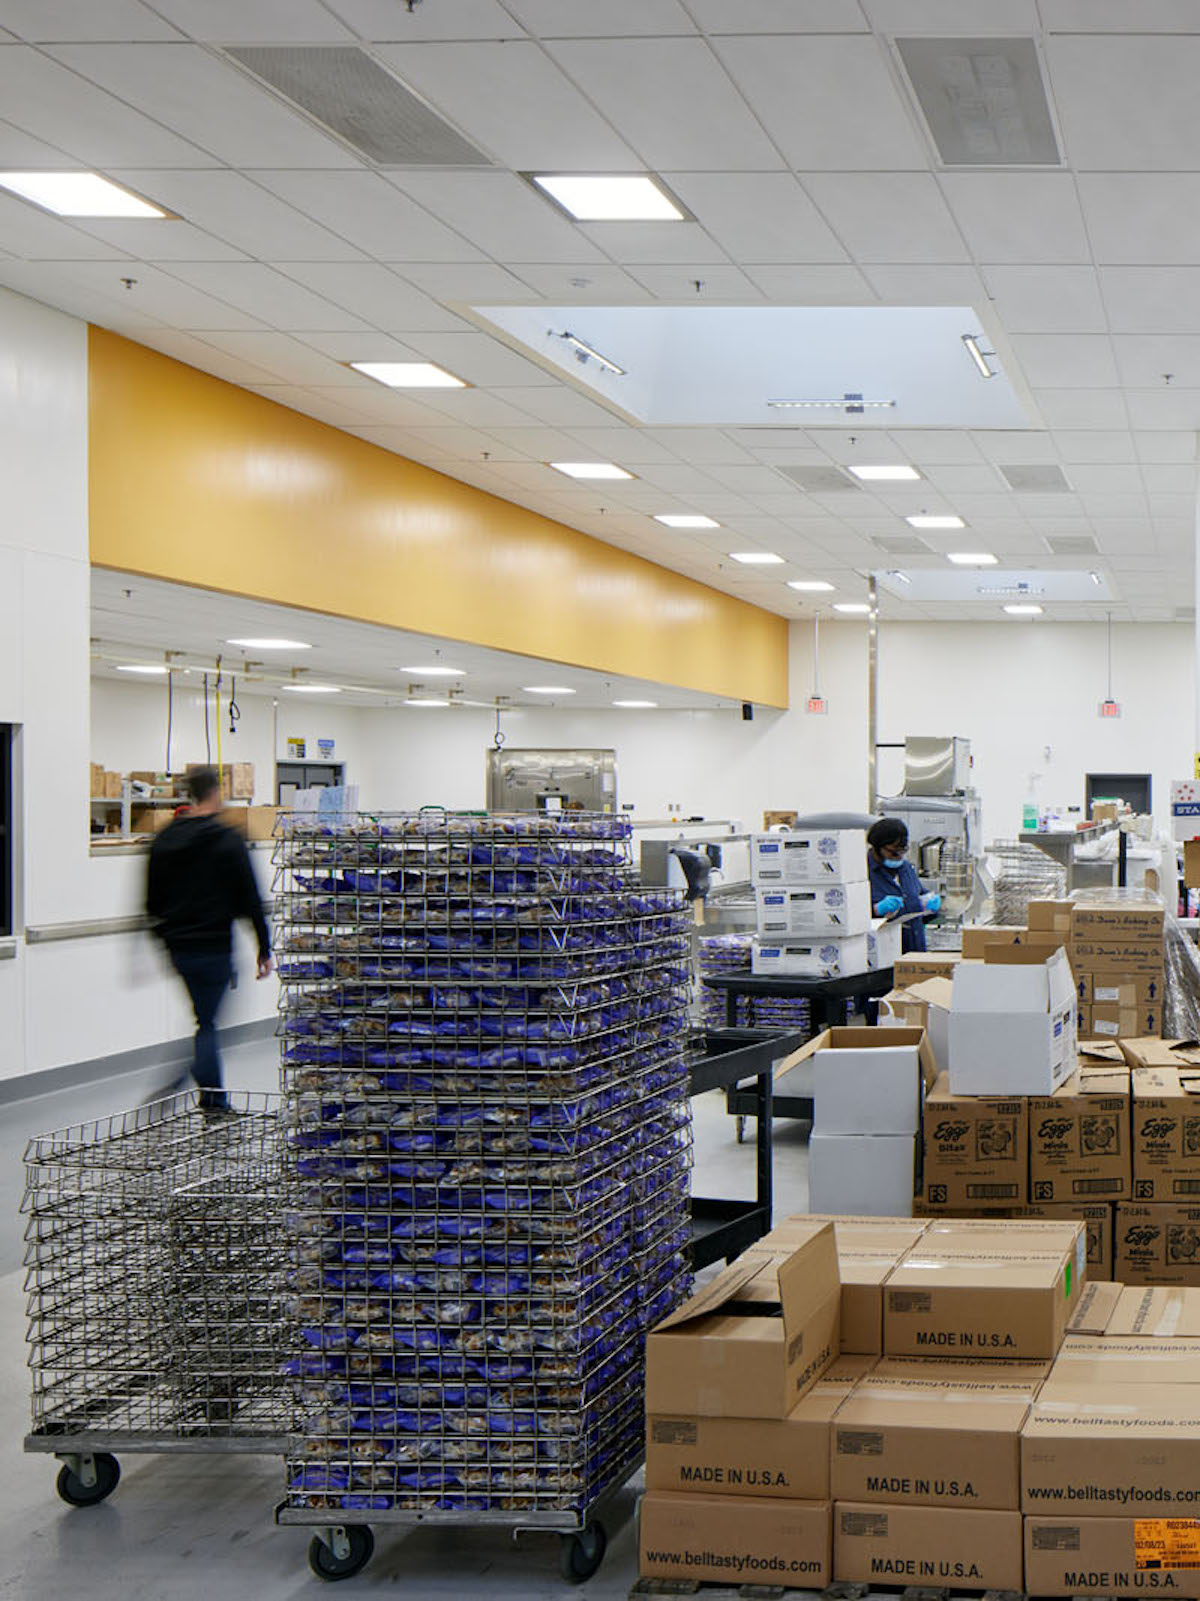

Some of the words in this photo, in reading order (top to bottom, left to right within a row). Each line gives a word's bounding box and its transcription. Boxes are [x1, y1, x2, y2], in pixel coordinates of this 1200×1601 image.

[933, 1121, 970, 1141] Eggo
[1038, 1118, 1074, 1139] Eggo
[1141, 1118, 1177, 1139] Eggo
[930, 1186, 946, 1201] FS
[1035, 1183, 1052, 1200] FS
[1137, 1182, 1153, 1198] FS
[1124, 1225, 1161, 1245] Eggo
[916, 1332, 956, 1346] MADE
[960, 1333, 973, 1346] IN
[977, 1333, 1017, 1347] U.S.A.
[867, 1378, 1032, 1391] www.belltastyfoods.com
[680, 1466, 723, 1482] MADE
[728, 1469, 742, 1483] IN
[746, 1470, 790, 1486] U.S.A.
[867, 1477, 910, 1493] MADE
[915, 1480, 929, 1494] IN
[934, 1481, 978, 1497] U.S.A.
[647, 1550, 822, 1573] www.belltastyfoods.com
[871, 1558, 915, 1573] MADE
[920, 1560, 934, 1575] IN
[939, 1561, 983, 1578] U.S.A.
[1064, 1572, 1110, 1587] MADE
[1114, 1573, 1129, 1587] IN
[1134, 1573, 1180, 1588] U.S.A.
